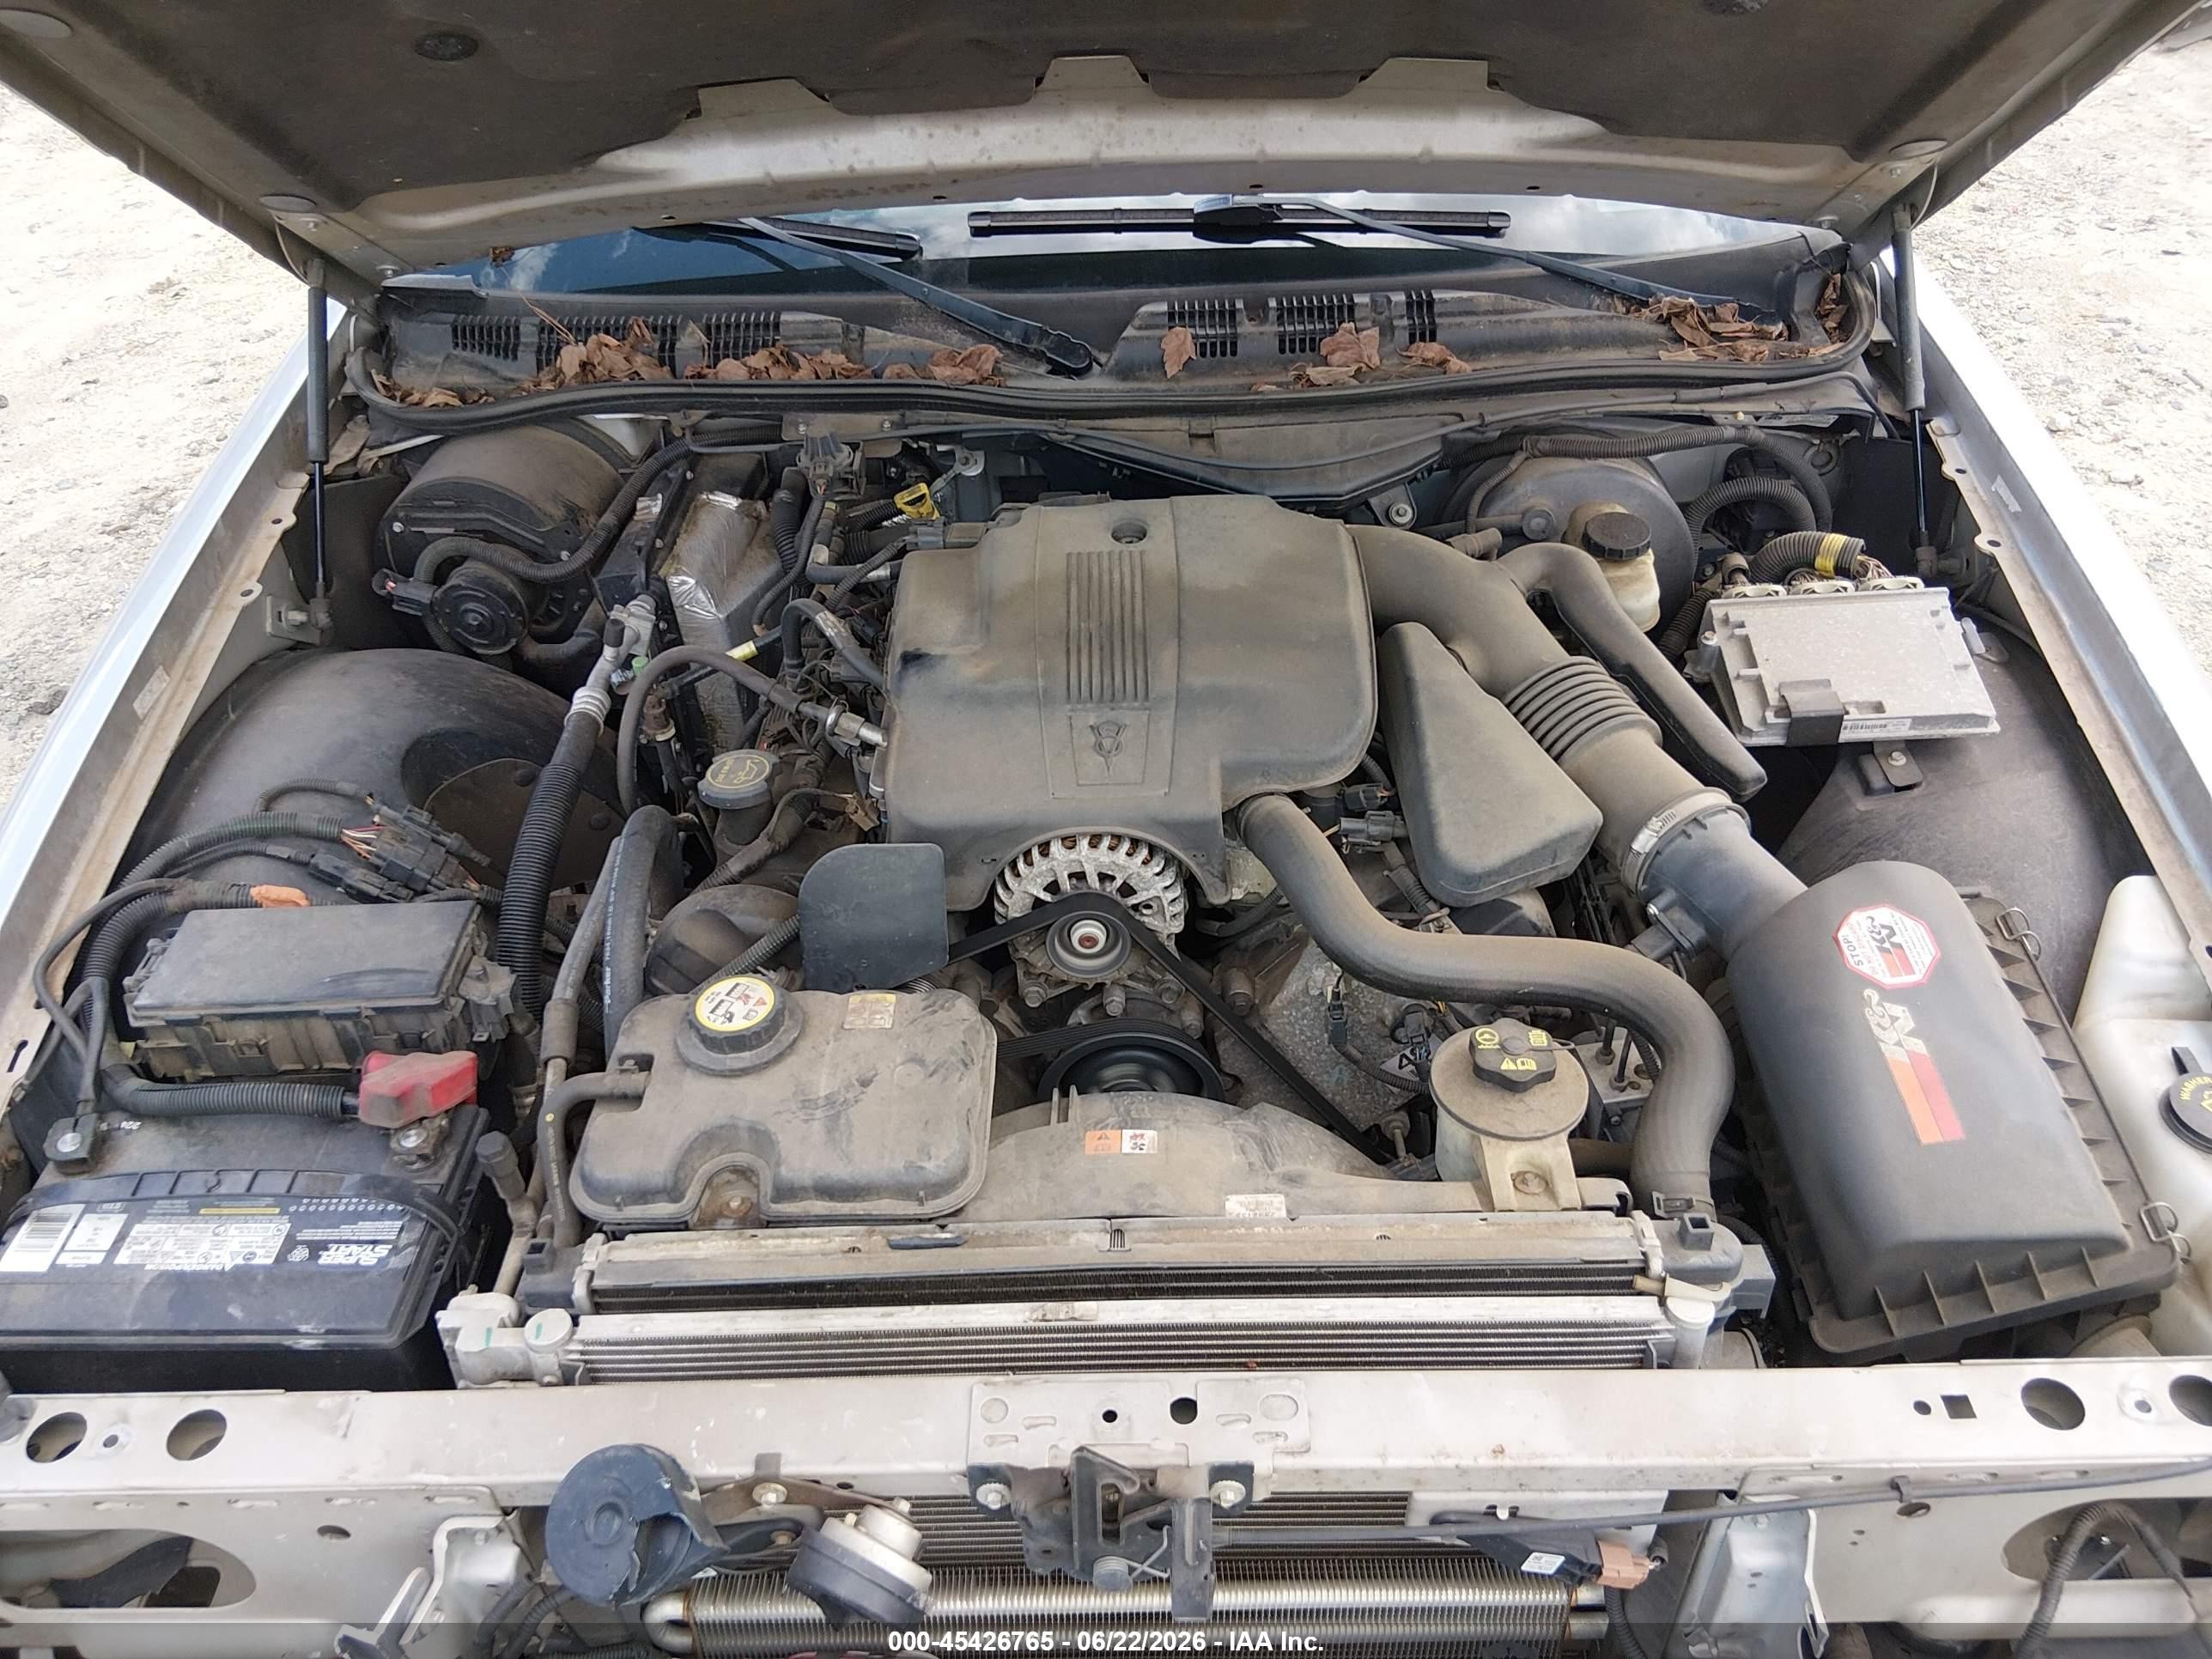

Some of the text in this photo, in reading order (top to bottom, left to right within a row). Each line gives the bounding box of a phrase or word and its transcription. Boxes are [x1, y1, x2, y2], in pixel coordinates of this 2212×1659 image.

[1841, 933, 1864, 967] STOP!
[327, 1244, 393, 1257] START
[317, 1251, 380, 1266] SUPER
